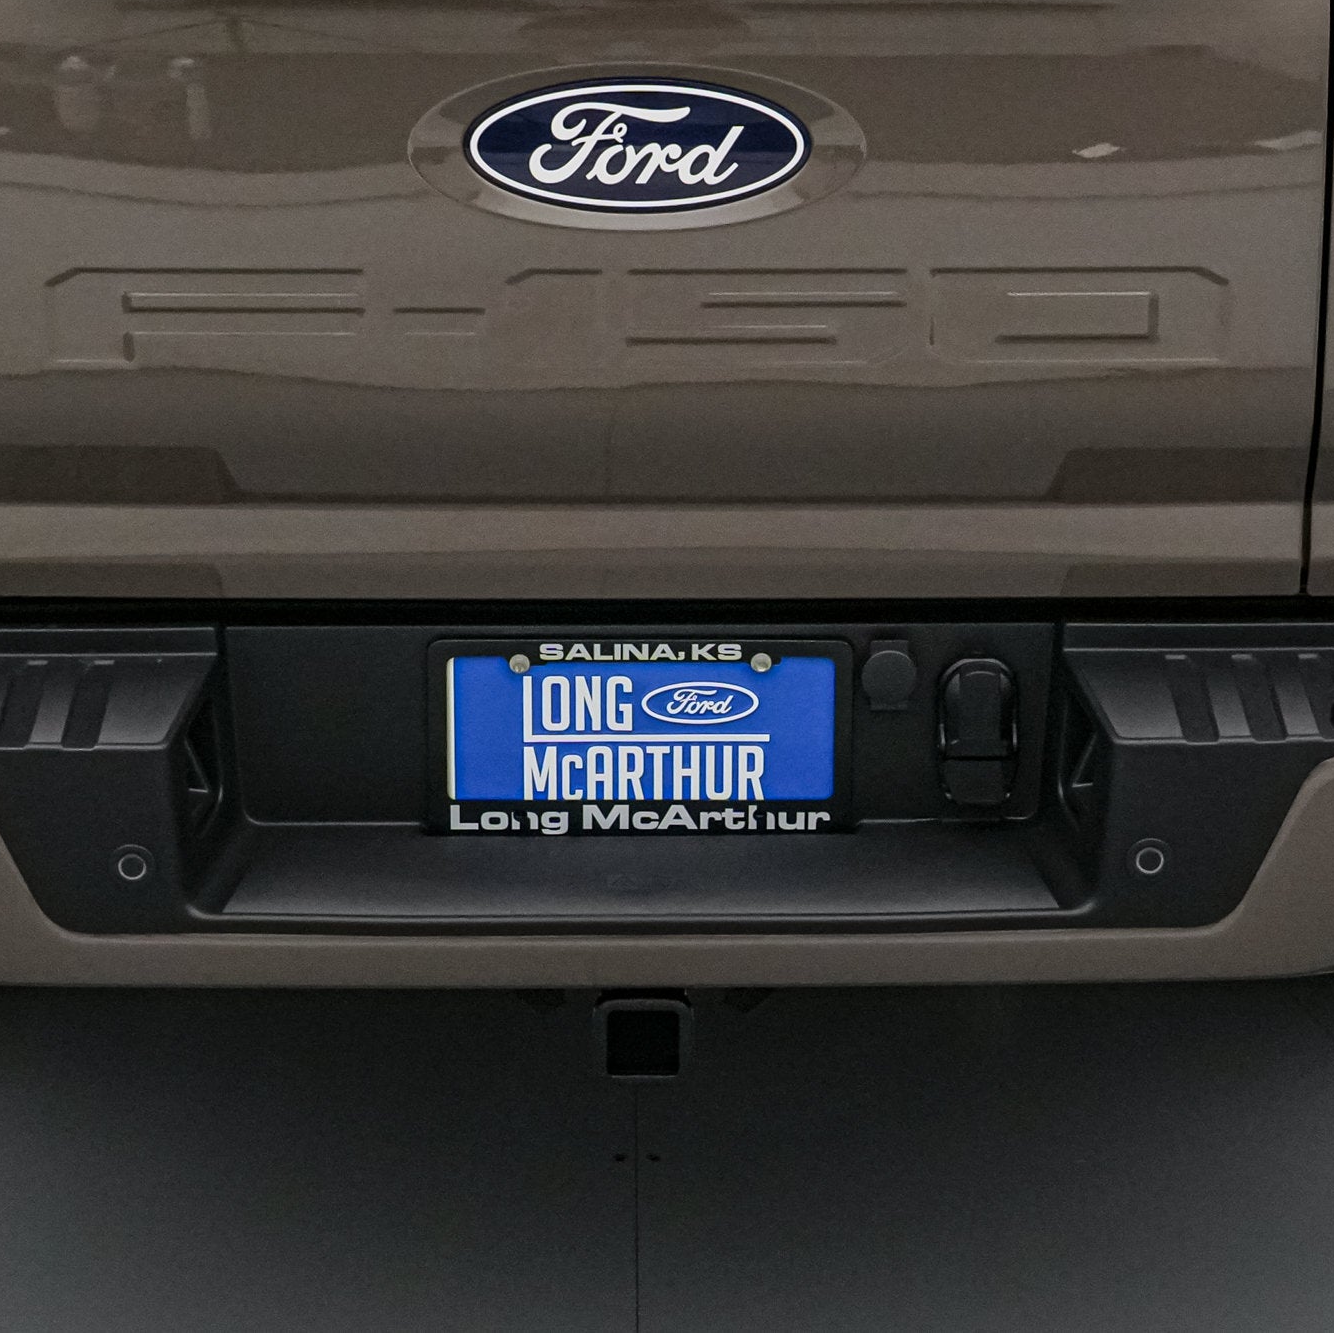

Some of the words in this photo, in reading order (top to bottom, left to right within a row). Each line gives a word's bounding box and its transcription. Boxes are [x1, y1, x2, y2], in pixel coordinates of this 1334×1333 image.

[529, 102, 743, 186] Ford
[539, 642, 686, 661] SALINA,
[691, 643, 742, 661] KS
[523, 675, 633, 742] LONG
[665, 688, 734, 716] Ford
[523, 745, 765, 800] McARTHUR
[449, 804, 569, 835] Long
[582, 804, 831, 830] McArthur
